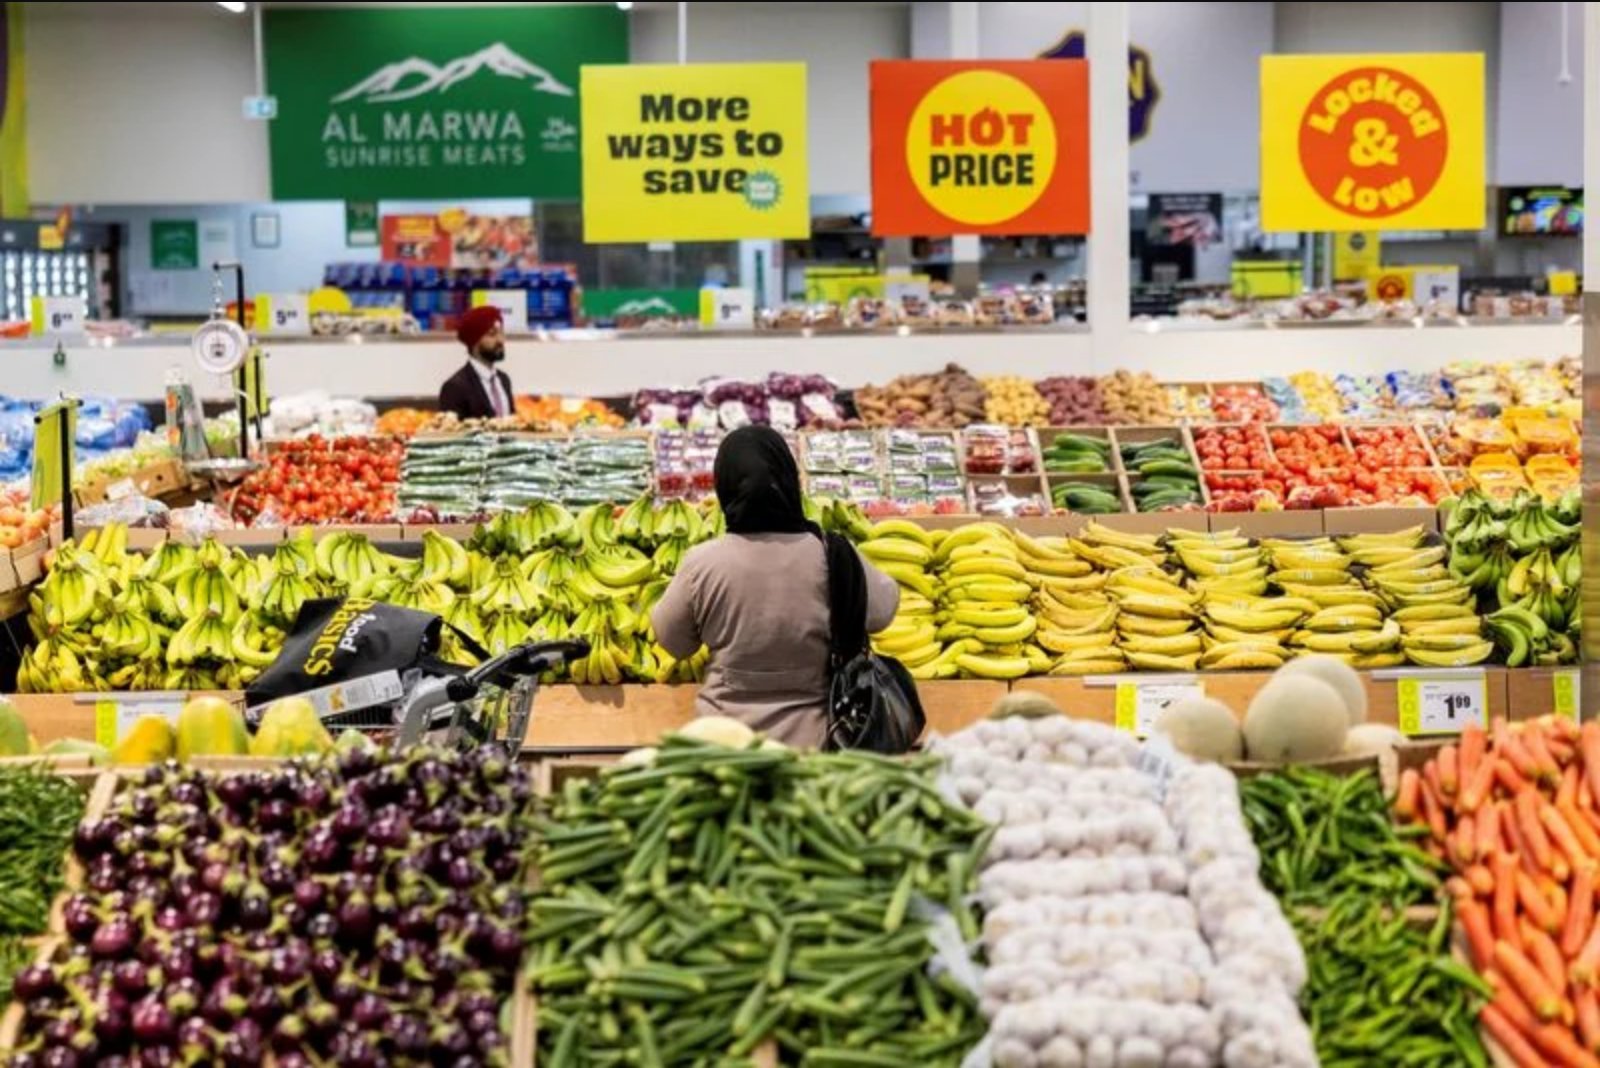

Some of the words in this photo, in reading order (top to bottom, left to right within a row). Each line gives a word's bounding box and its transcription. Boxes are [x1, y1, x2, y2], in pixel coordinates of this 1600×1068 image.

[640, 94, 750, 123] More
[321, 111, 368, 142] AL
[382, 109, 525, 141] MARWA
[930, 107, 1034, 147] HOT
[326, 145, 431, 168] SUNRISE
[442, 143, 527, 166] MEATS
[608, 132, 724, 163] ways
[735, 129, 783, 157] to
[1349, 117, 1399, 168] &
[643, 168, 749, 194] save
[930, 153, 1034, 187] PRICE
